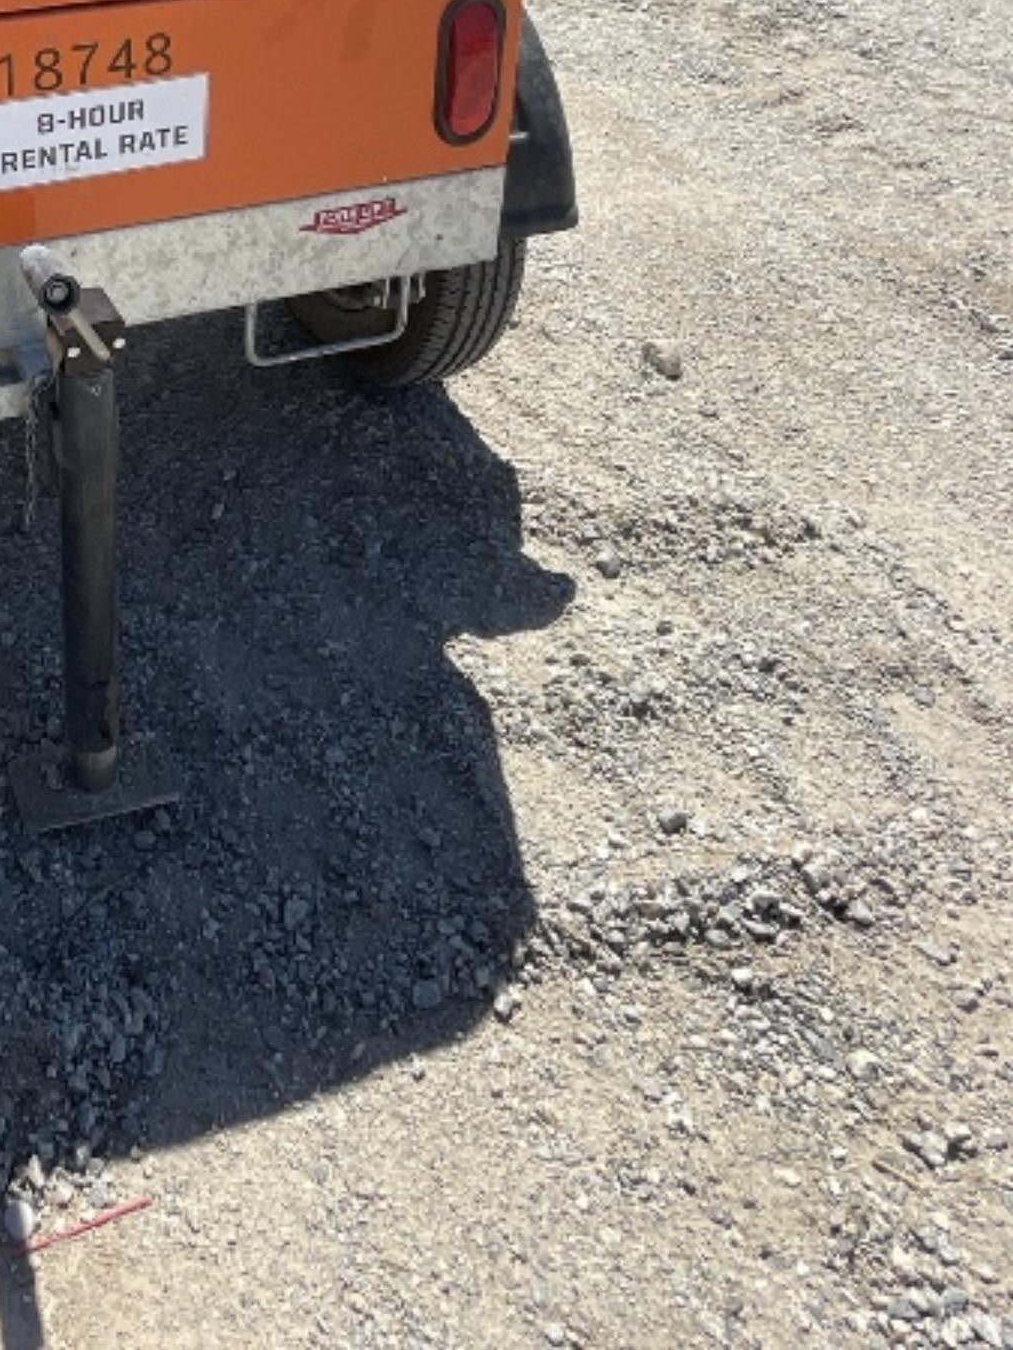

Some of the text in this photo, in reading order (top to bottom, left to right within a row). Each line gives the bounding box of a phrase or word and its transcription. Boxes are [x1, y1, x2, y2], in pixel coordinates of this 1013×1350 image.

[37, 99, 145, 135] 8-HOUR
[0, 125, 189, 176] RENTAL RATE
